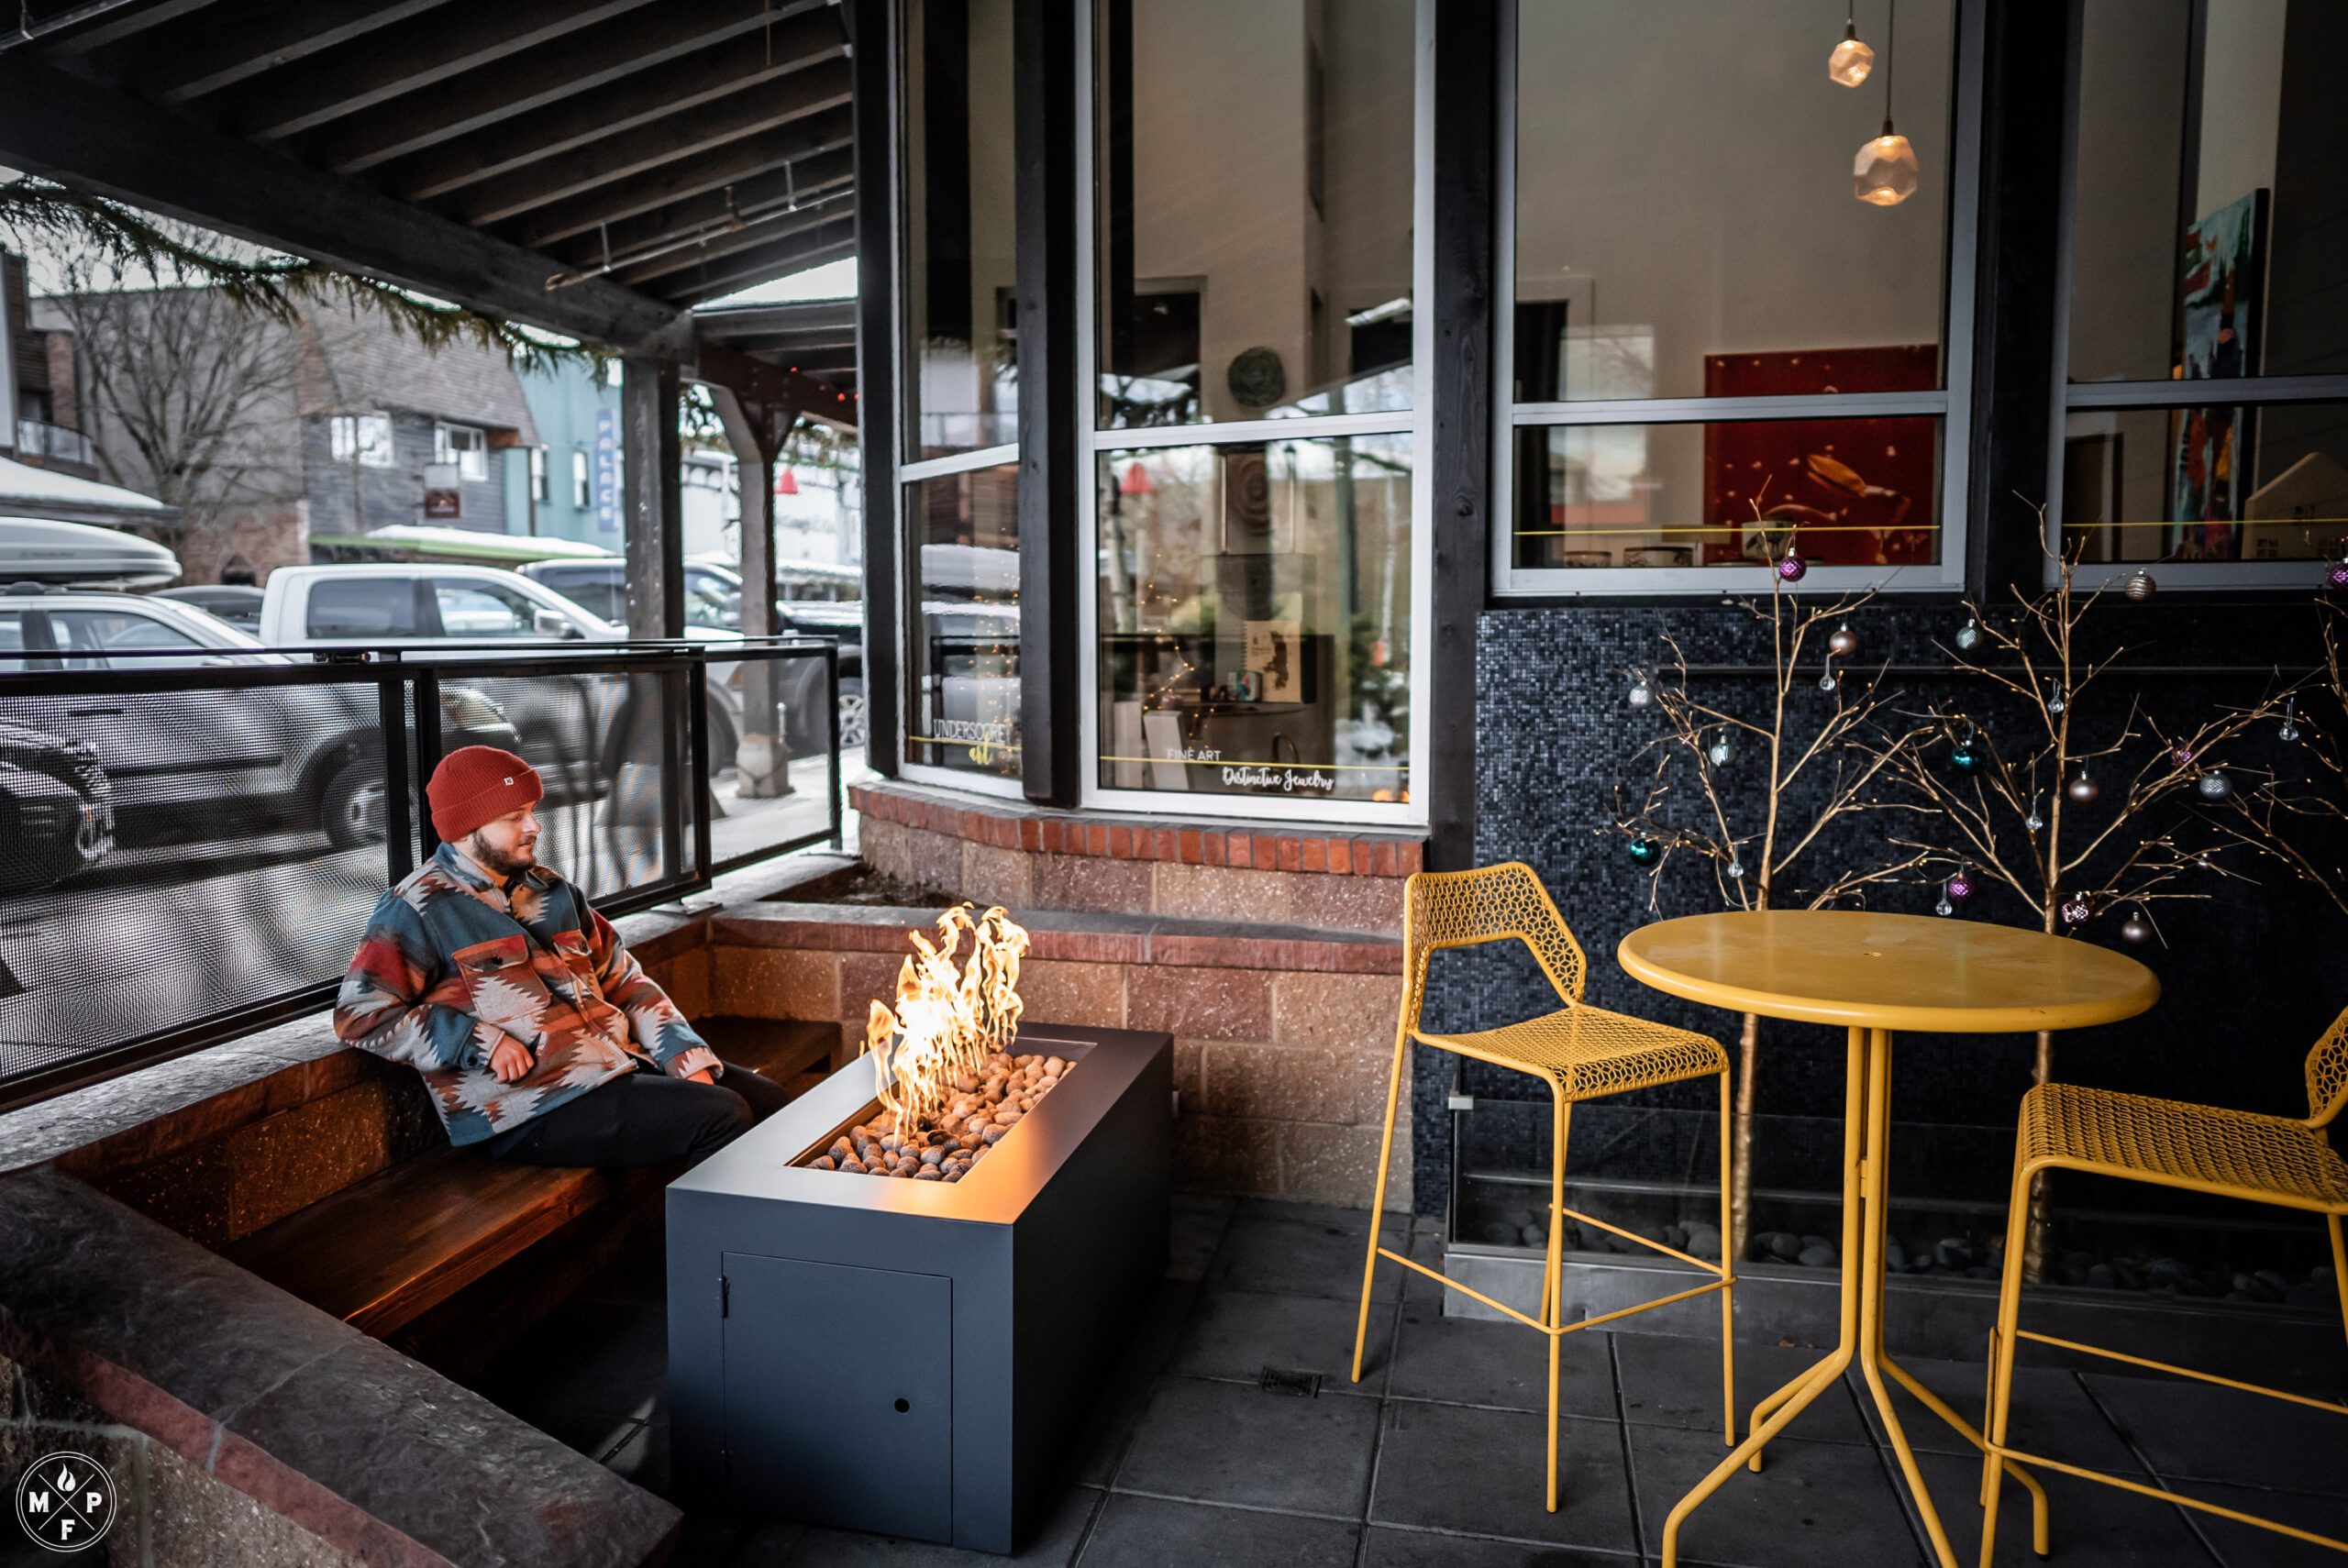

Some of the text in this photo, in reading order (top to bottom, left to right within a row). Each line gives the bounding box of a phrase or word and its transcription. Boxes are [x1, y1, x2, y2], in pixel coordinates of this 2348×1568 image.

[1167, 747, 1222, 762] FINE ART
[1222, 766, 1335, 791] Distinctive Jewelry
